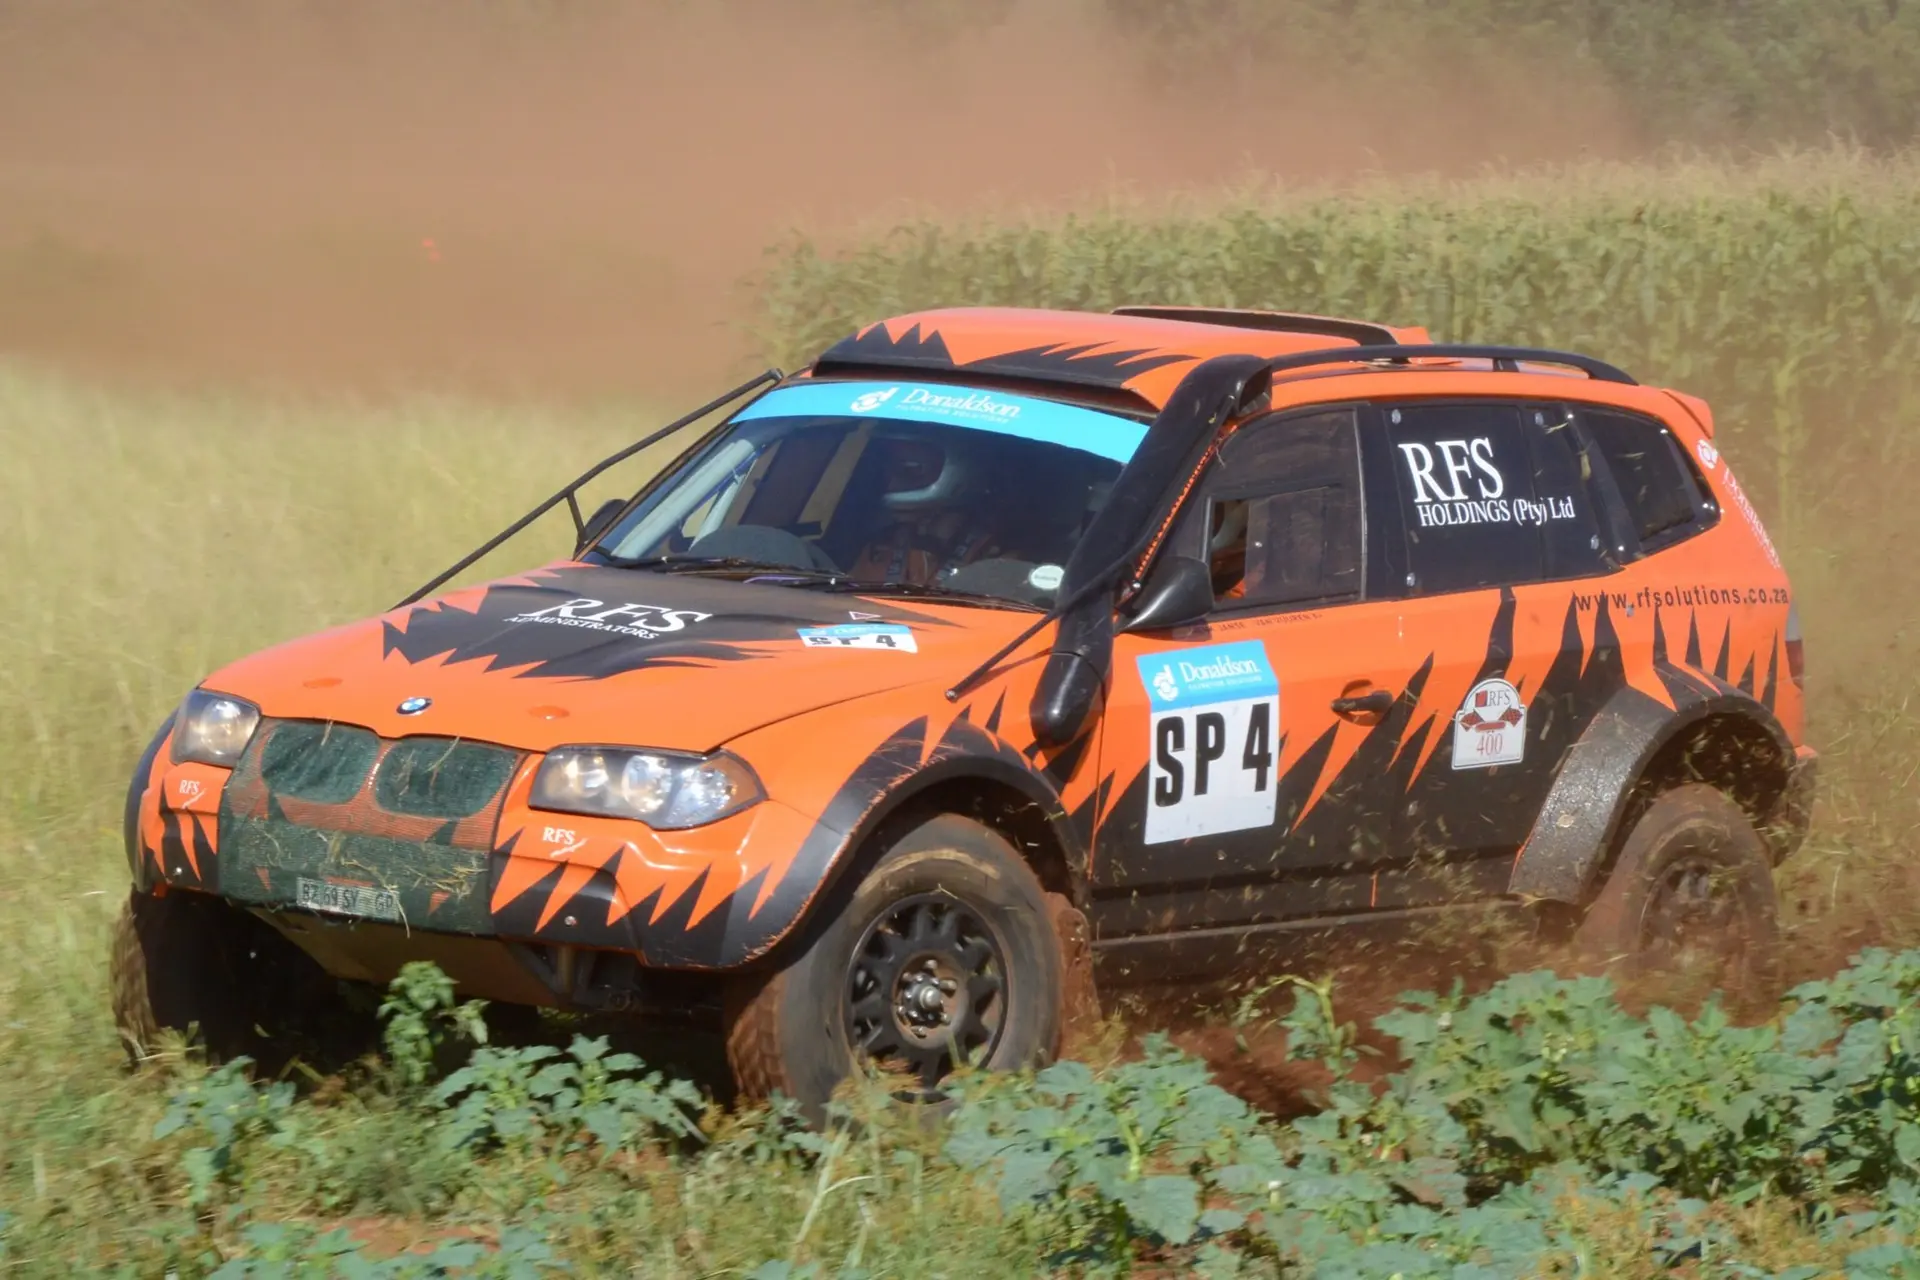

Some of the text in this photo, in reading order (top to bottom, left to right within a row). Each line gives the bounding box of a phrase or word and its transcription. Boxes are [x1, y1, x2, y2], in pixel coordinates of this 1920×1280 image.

[902, 388, 1021, 417] Donaldson
[1398, 437, 1504, 503] RFS
[1416, 495, 1576, 527] HOLDINGS (Pty) Ltd
[503, 615, 660, 640] ADMINISTRATORS
[518, 598, 713, 632] RFS
[876, 634, 897, 648] 4
[1178, 655, 1261, 683] Donaldson
[1487, 689, 1512, 707] RFS
[1154, 702, 1272, 808] SP 4
[1476, 733, 1503, 756] 400
[179, 779, 200, 796] RFS
[543, 826, 576, 846] RFS
